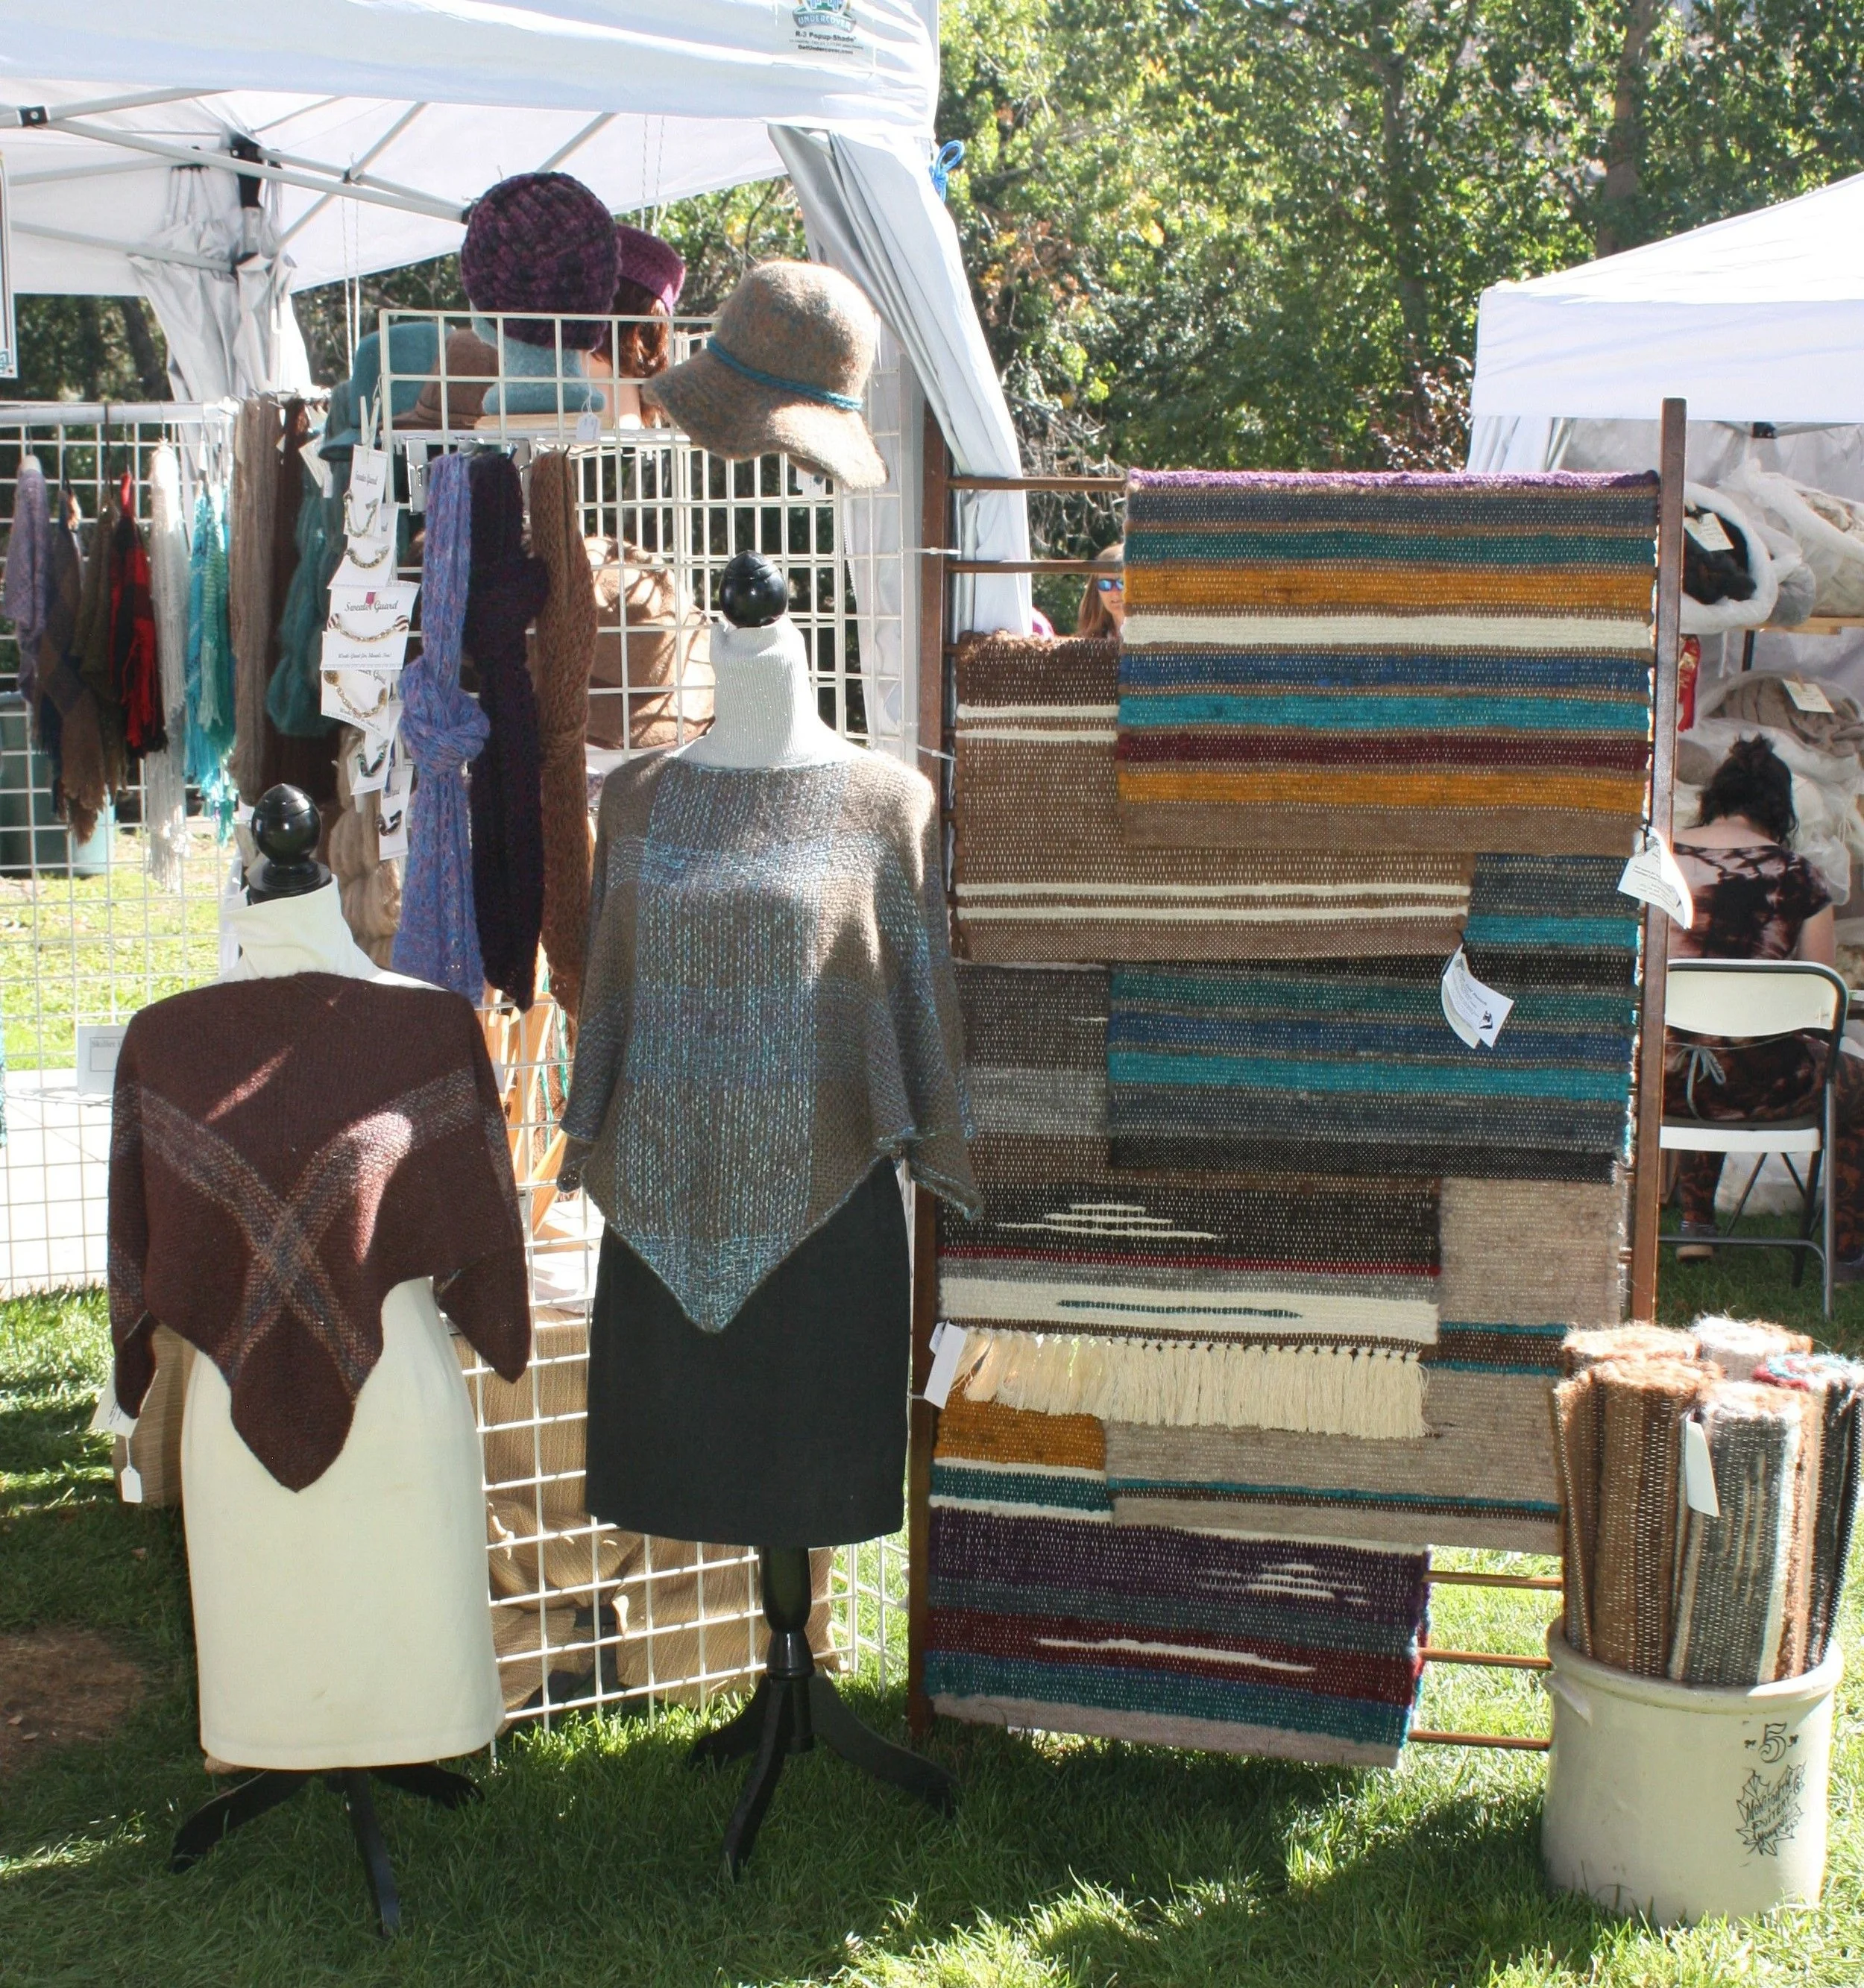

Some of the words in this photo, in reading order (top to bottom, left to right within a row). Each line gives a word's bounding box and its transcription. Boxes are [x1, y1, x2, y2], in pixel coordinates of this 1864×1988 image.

[798, 13, 851, 31] UNDERCOVER
[374, 599, 399, 613] Guard
[1758, 1722, 1788, 1764] 5
